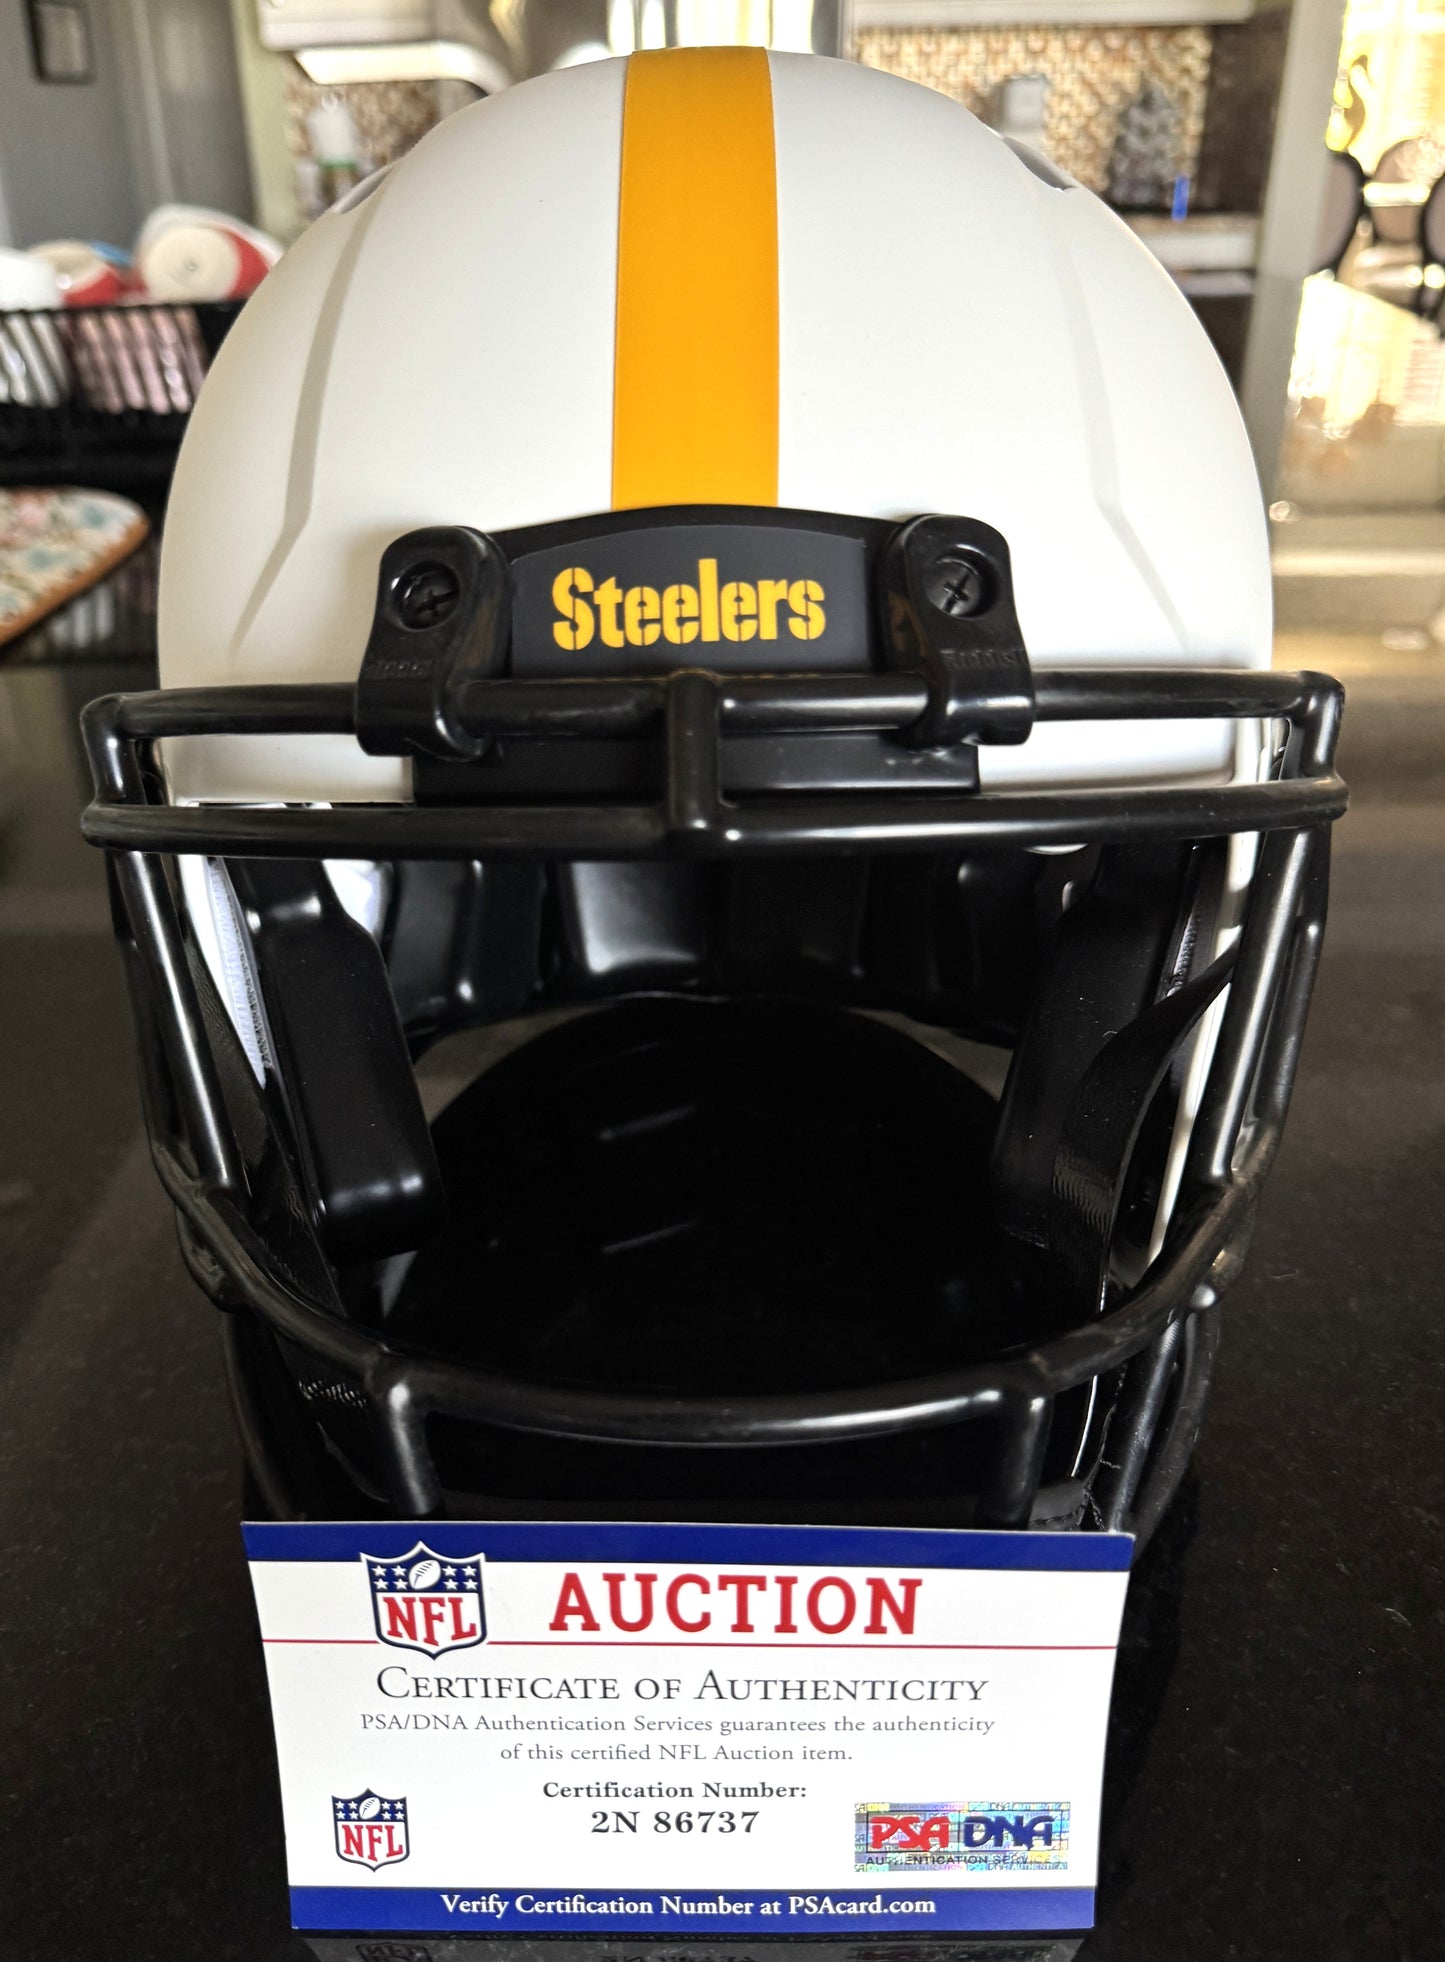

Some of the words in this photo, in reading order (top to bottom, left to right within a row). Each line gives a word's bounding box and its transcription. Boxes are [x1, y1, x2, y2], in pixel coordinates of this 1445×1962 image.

[552, 558, 826, 651] Steelers
[383, 1597, 477, 1646] NFL
[549, 1573, 922, 1635] AUCTION
[376, 1665, 621, 1700] CERTIFICATE
[634, 1677, 682, 1700] OF
[694, 1669, 990, 1701] AUTHENTICITY
[360, 1713, 468, 1730] PSA/DNA
[475, 1714, 626, 1731] Authentication
[633, 1715, 713, 1731] Services
[720, 1718, 826, 1736] guarantees
[834, 1715, 866, 1732] the
[872, 1715, 995, 1736] authenticity
[500, 1743, 523, 1760] of
[528, 1743, 564, 1760] this
[570, 1744, 651, 1760] certified
[658, 1744, 707, 1760] NFL
[712, 1744, 794, 1760] Auction
[802, 1744, 853, 1760] item.
[542, 1781, 695, 1799] Certification
[701, 1781, 807, 1799] Number:
[590, 1810, 641, 1834] 2N
[653, 1810, 760, 1834] 86737
[870, 1816, 950, 1851] PSA
[963, 1816, 1055, 1851] DNA
[342, 1825, 403, 1861] NFL
[440, 1893, 510, 1919] Verify
[514, 1894, 654, 1915] Certification
[659, 1895, 755, 1916] Number
[759, 1900, 782, 1915] at
[788, 1894, 937, 1916] PSAcard.com
